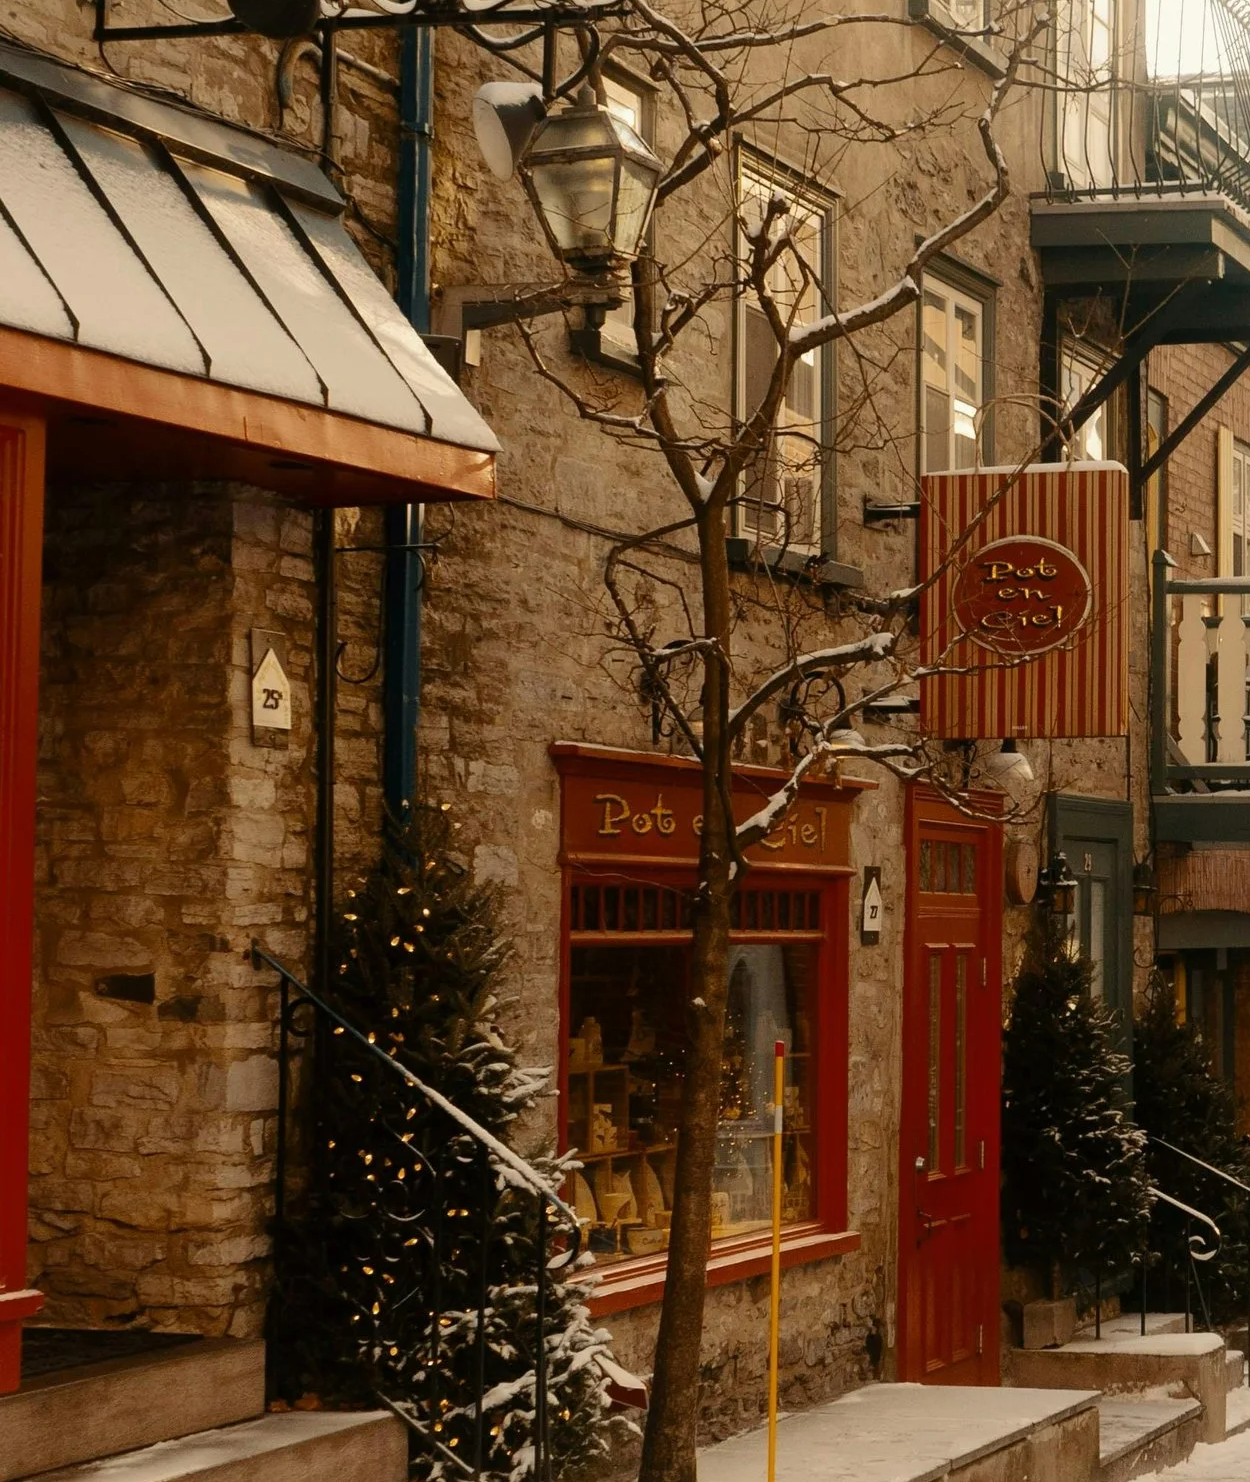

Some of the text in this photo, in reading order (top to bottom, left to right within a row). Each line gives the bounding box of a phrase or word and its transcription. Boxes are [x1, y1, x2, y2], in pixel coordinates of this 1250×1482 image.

[983, 557, 1058, 580] Pot
[998, 587, 1052, 600] en
[981, 605, 1063, 628] Ciel
[594, 792, 676, 834] Pot
